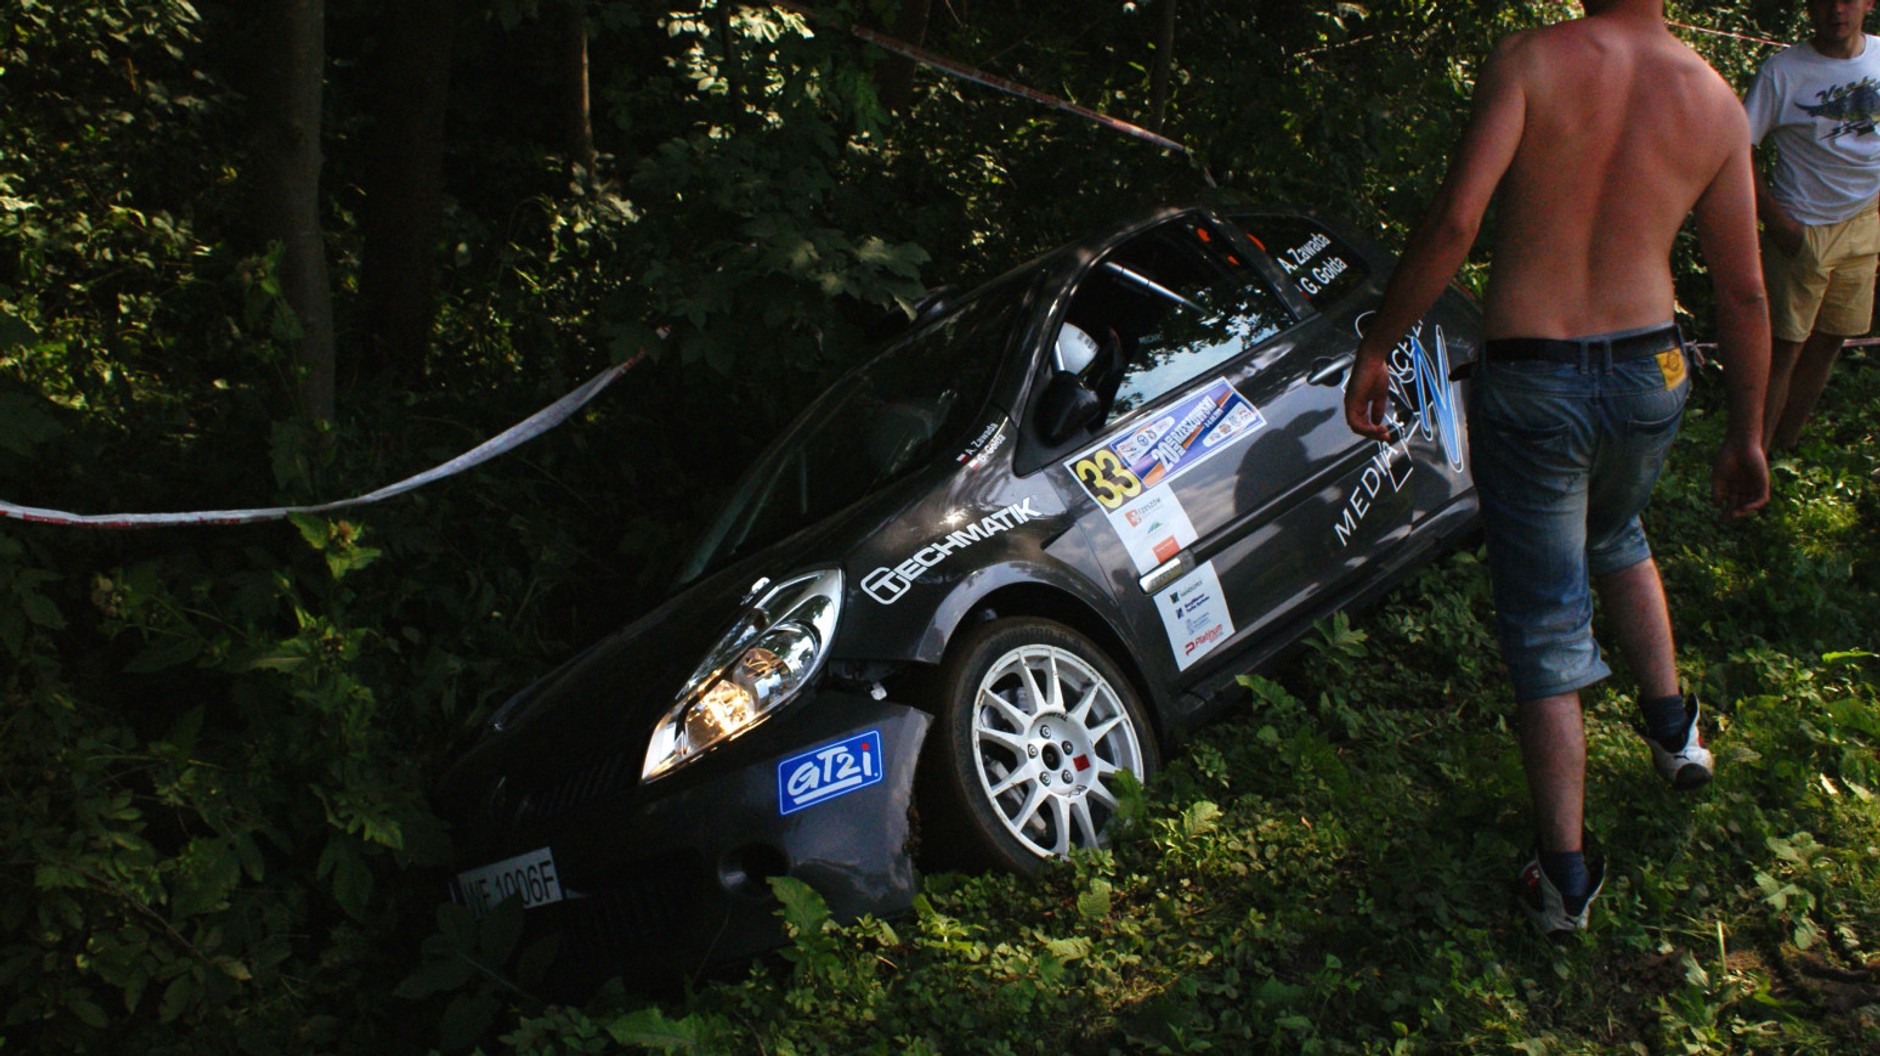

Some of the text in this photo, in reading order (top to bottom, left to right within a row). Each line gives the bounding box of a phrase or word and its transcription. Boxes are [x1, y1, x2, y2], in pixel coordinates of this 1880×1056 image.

[1277, 232, 1332, 275] A. Zawada
[1300, 256, 1348, 295] G. Golda
[1076, 449, 1142, 509] 33
[1151, 441, 1180, 473] 20
[1334, 441, 1399, 547] MEDIA
[860, 496, 1043, 605] TECHMATIK
